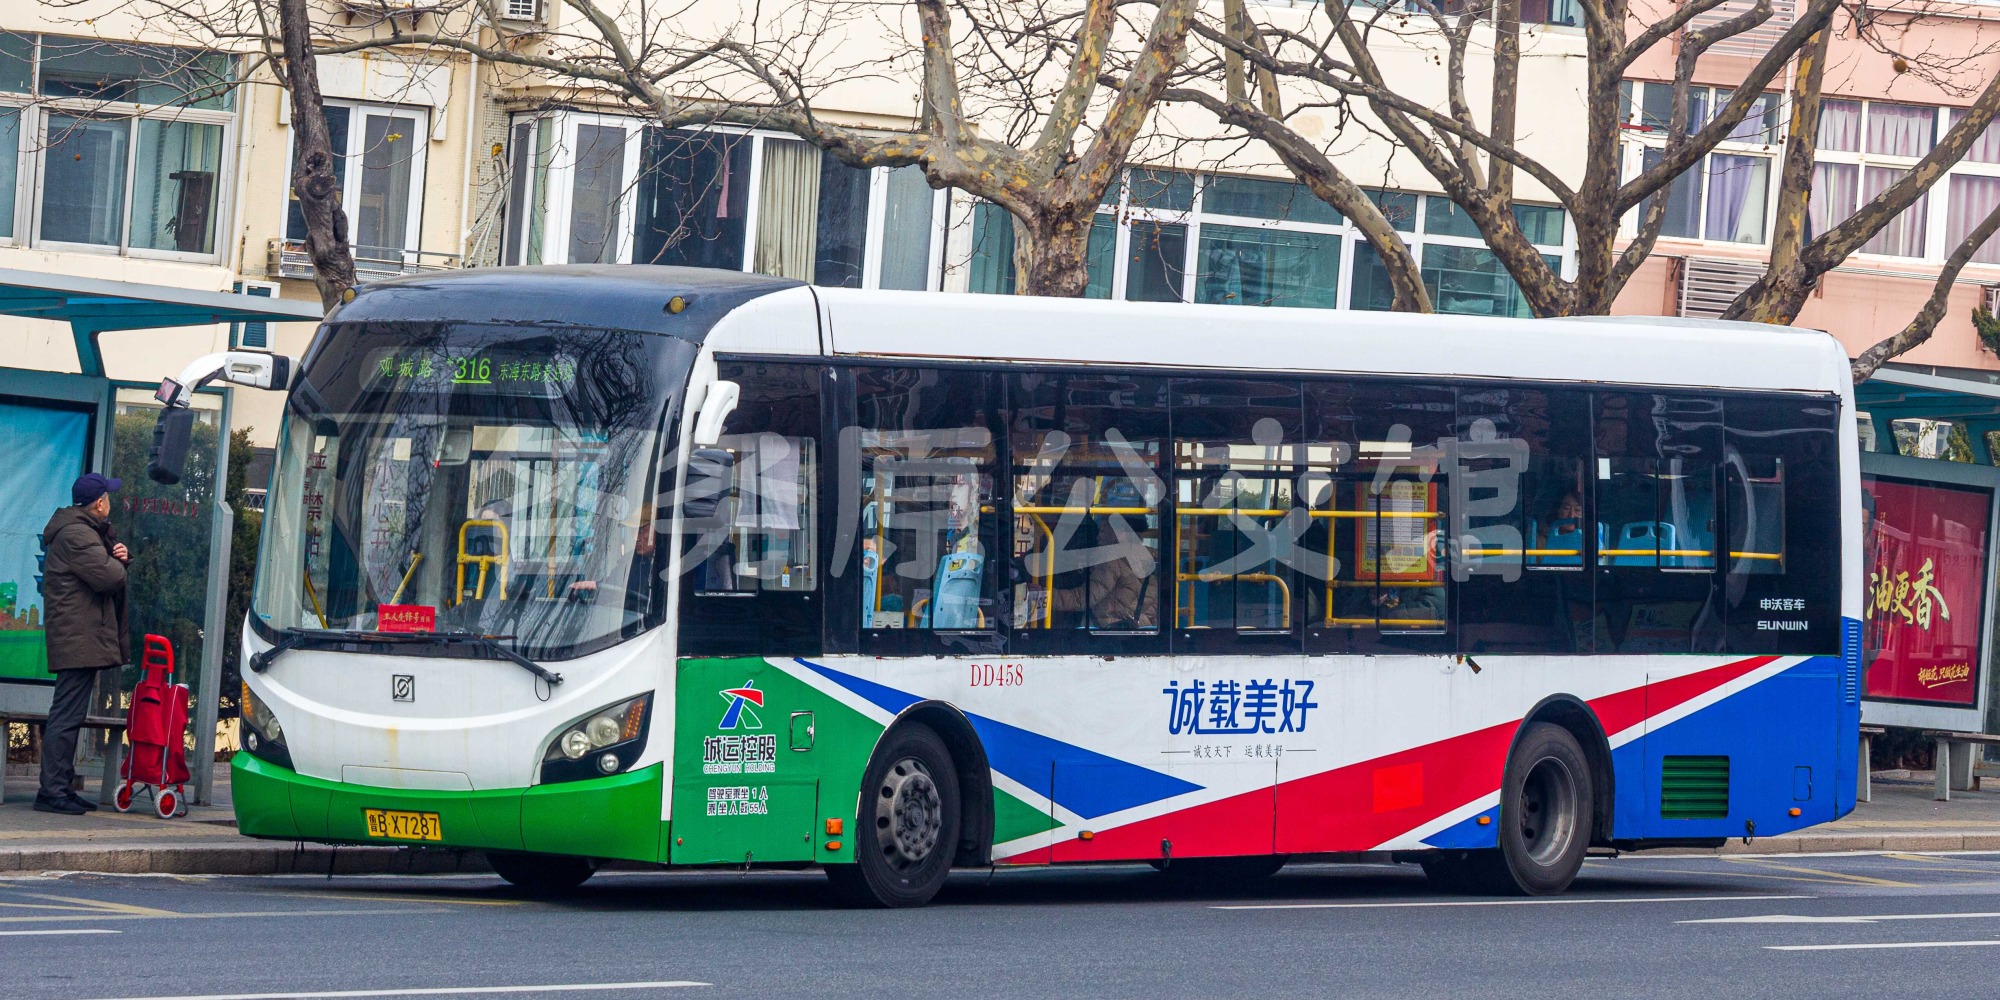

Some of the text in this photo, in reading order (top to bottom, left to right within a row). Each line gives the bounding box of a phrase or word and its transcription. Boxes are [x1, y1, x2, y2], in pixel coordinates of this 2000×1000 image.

[380, 357, 433, 379] 观城路
[454, 357, 491, 380] 316
[1760, 598, 1805, 611] 申沃客车
[1866, 558, 1949, 631] 油更香
[1757, 620, 1808, 631] SUNWIN
[970, 664, 1023, 686] DD458
[1162, 679, 1318, 735] 诚载美好
[703, 734, 776, 763] 城运控股
[1244, 744, 1283, 757] 运载美好
[703, 762, 775, 774] CHENGYUN HOLDING
